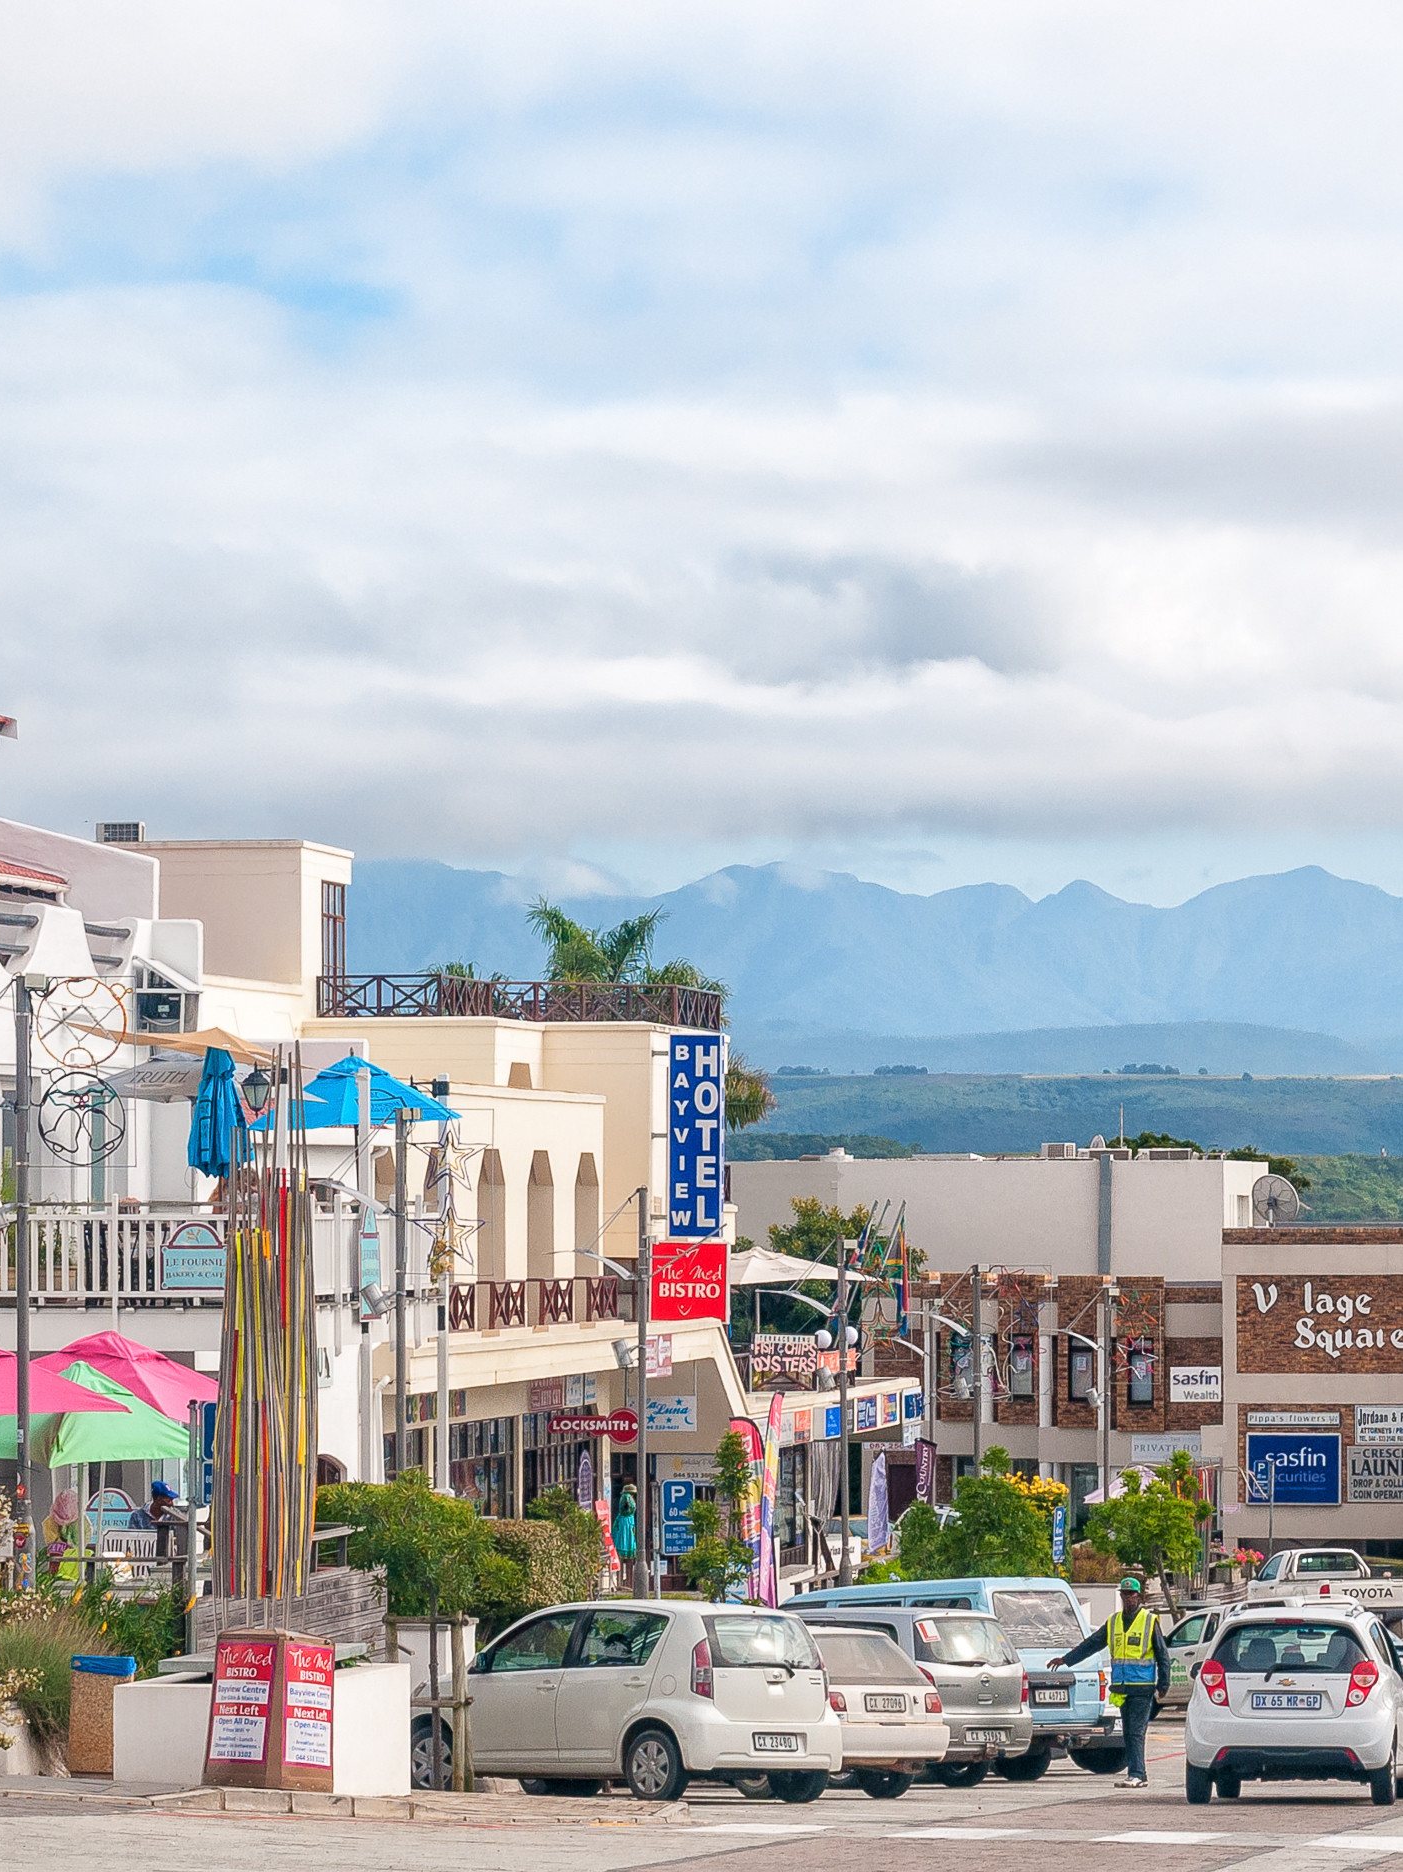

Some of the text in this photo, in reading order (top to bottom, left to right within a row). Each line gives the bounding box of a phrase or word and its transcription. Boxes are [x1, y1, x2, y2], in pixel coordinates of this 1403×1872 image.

[671, 1045, 691, 1226] BAYVIEW
[693, 1045, 719, 1228] HOTEL
[166, 1258, 225, 1267] LE FOURNIL
[658, 1263, 723, 1281] The Med
[658, 1283, 721, 1298] BISTRO
[755, 1342, 774, 1355] FISH
[784, 1342, 817, 1357] CHIPS
[754, 1355, 817, 1372] OYSTERS
[1173, 1370, 1218, 1385] sasfin
[1183, 1390, 1219, 1399] Wealth
[654, 1403, 690, 1415] Luna
[1249, 1414, 1326, 1423] Pippa's flowers
[1358, 1409, 1397, 1426] Jordaan &
[553, 1420, 629, 1431] LOCKSMITH
[1134, 1444, 1177, 1452] PRIVATE
[1266, 1447, 1326, 1467] sasfin
[916, 1444, 929, 1494] COUNTRY
[1352, 1459, 1403, 1476] LAUN
[671, 1485, 686, 1503] P
[669, 1508, 678, 1517] 60
[1341, 1588, 1393, 1600] TOYOTA
[221, 1646, 273, 1666] The Med
[289, 1649, 311, 1668] The
[226, 1667, 257, 1677] BISTRO
[300, 1670, 325, 1683] BISTRO
[218, 1684, 267, 1694] Bayview Centre
[289, 1687, 316, 1699] Bayview
[869, 1700, 878, 1708] CX
[1255, 1695, 1318, 1707] DX 65 MR GP
[219, 1705, 259, 1715] Next Left
[293, 1707, 328, 1721] Next Left
[218, 1718, 232, 1726] Open
[244, 1718, 258, 1727] Day
[293, 1720, 310, 1729] Open
[757, 1737, 767, 1747] CX
